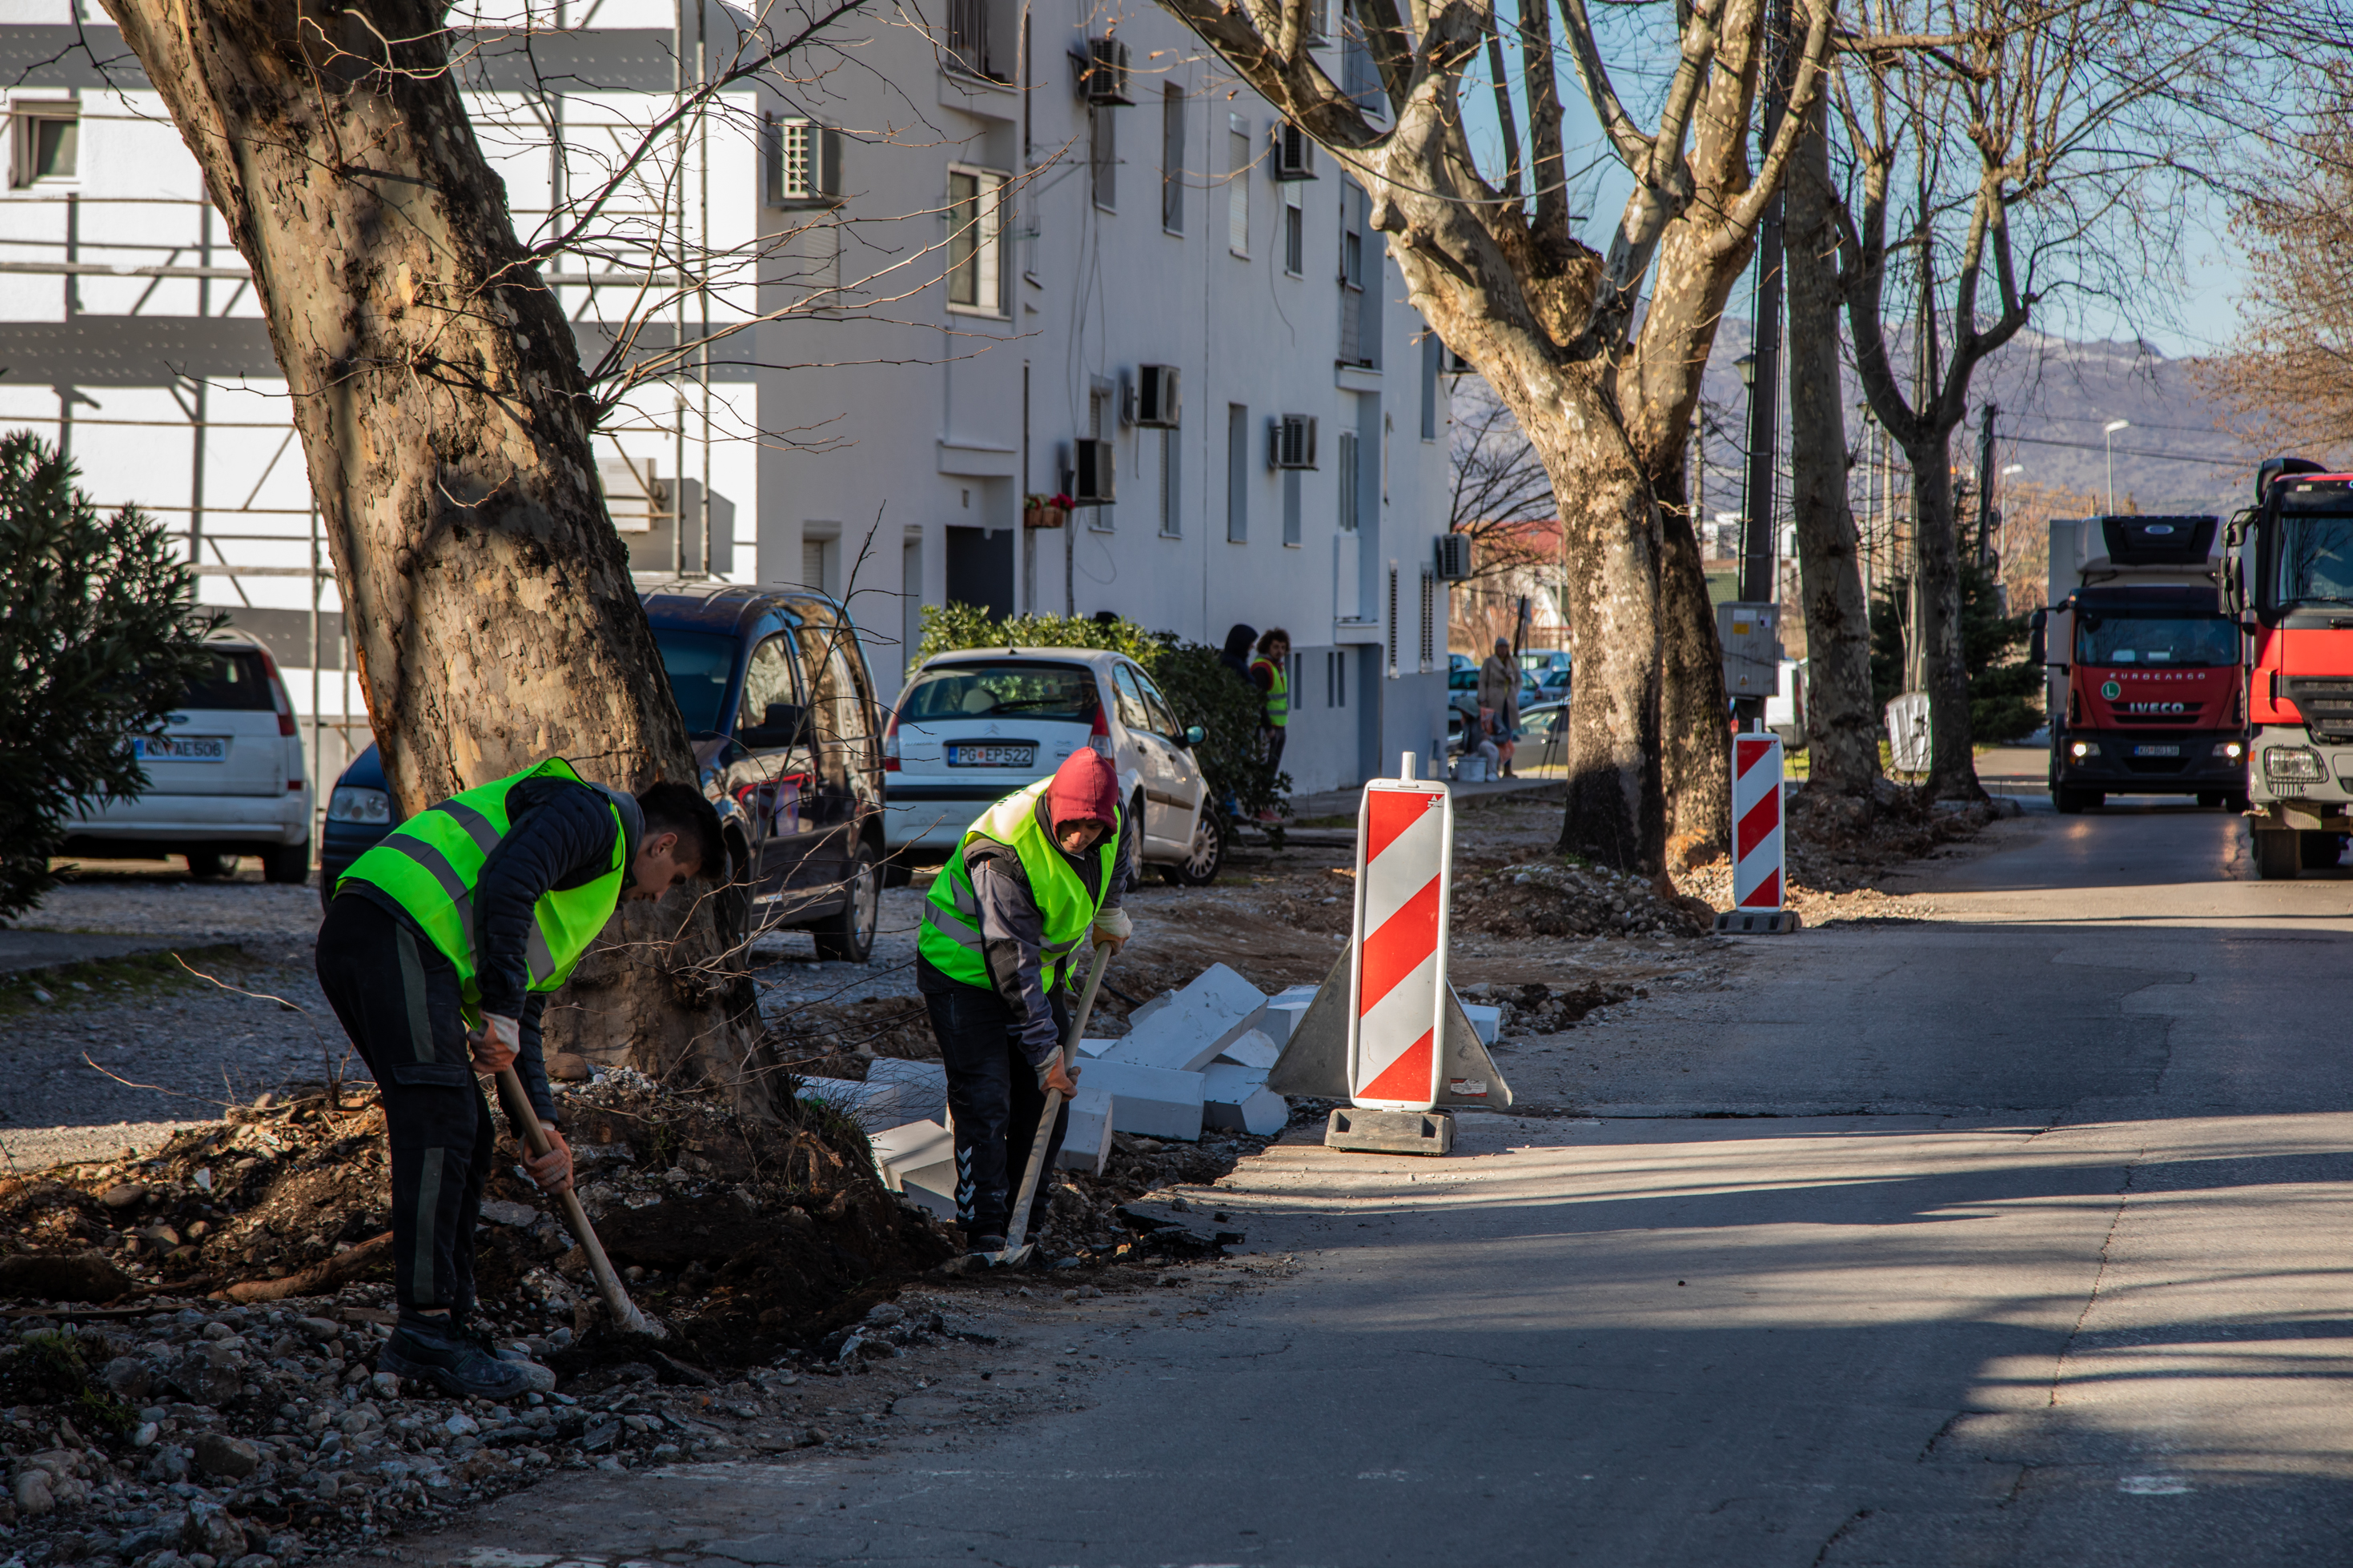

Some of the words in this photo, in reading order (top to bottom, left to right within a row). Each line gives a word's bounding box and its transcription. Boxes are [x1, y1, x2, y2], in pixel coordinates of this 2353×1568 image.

[2106, 684, 2114, 696] L
[2130, 702, 2184, 714] IVECO
[175, 741, 222, 756] AE506
[959, 748, 977, 761] PG
[986, 748, 1030, 761] EP522
